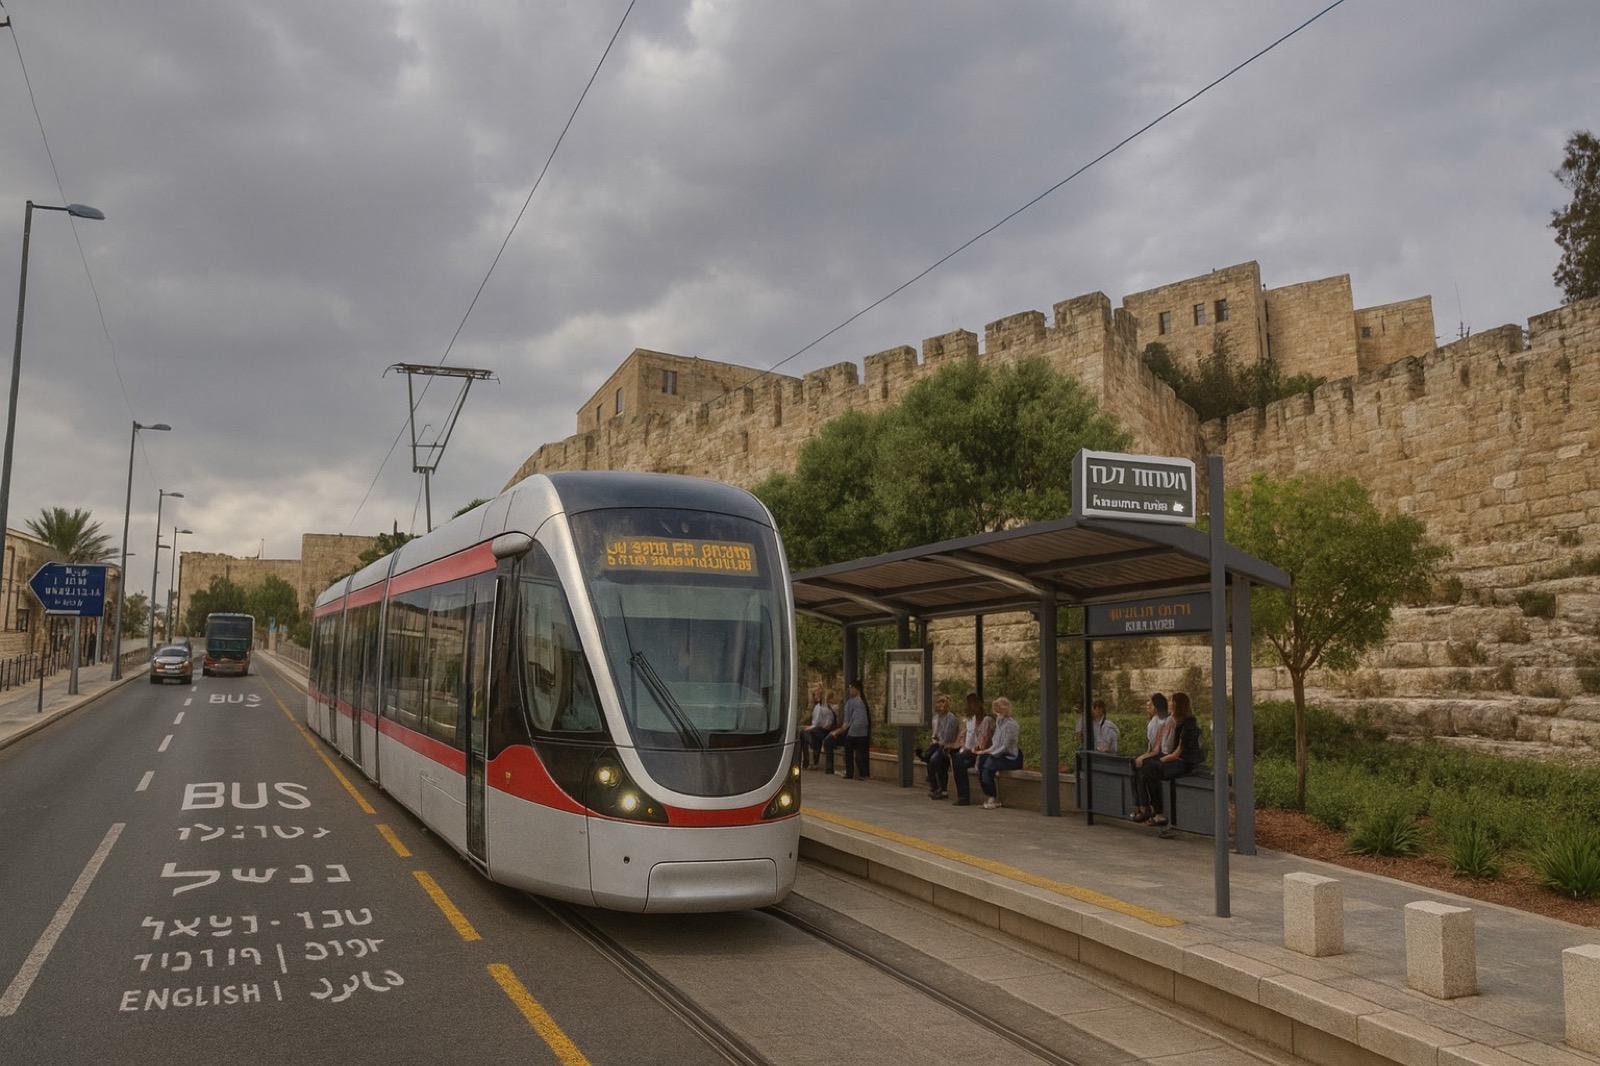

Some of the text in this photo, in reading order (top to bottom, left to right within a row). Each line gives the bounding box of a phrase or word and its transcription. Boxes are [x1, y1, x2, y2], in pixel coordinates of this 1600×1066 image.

[208, 694, 262, 707] BUS
[181, 782, 311, 810] BUS
[119, 983, 262, 1011] ENGLISH
